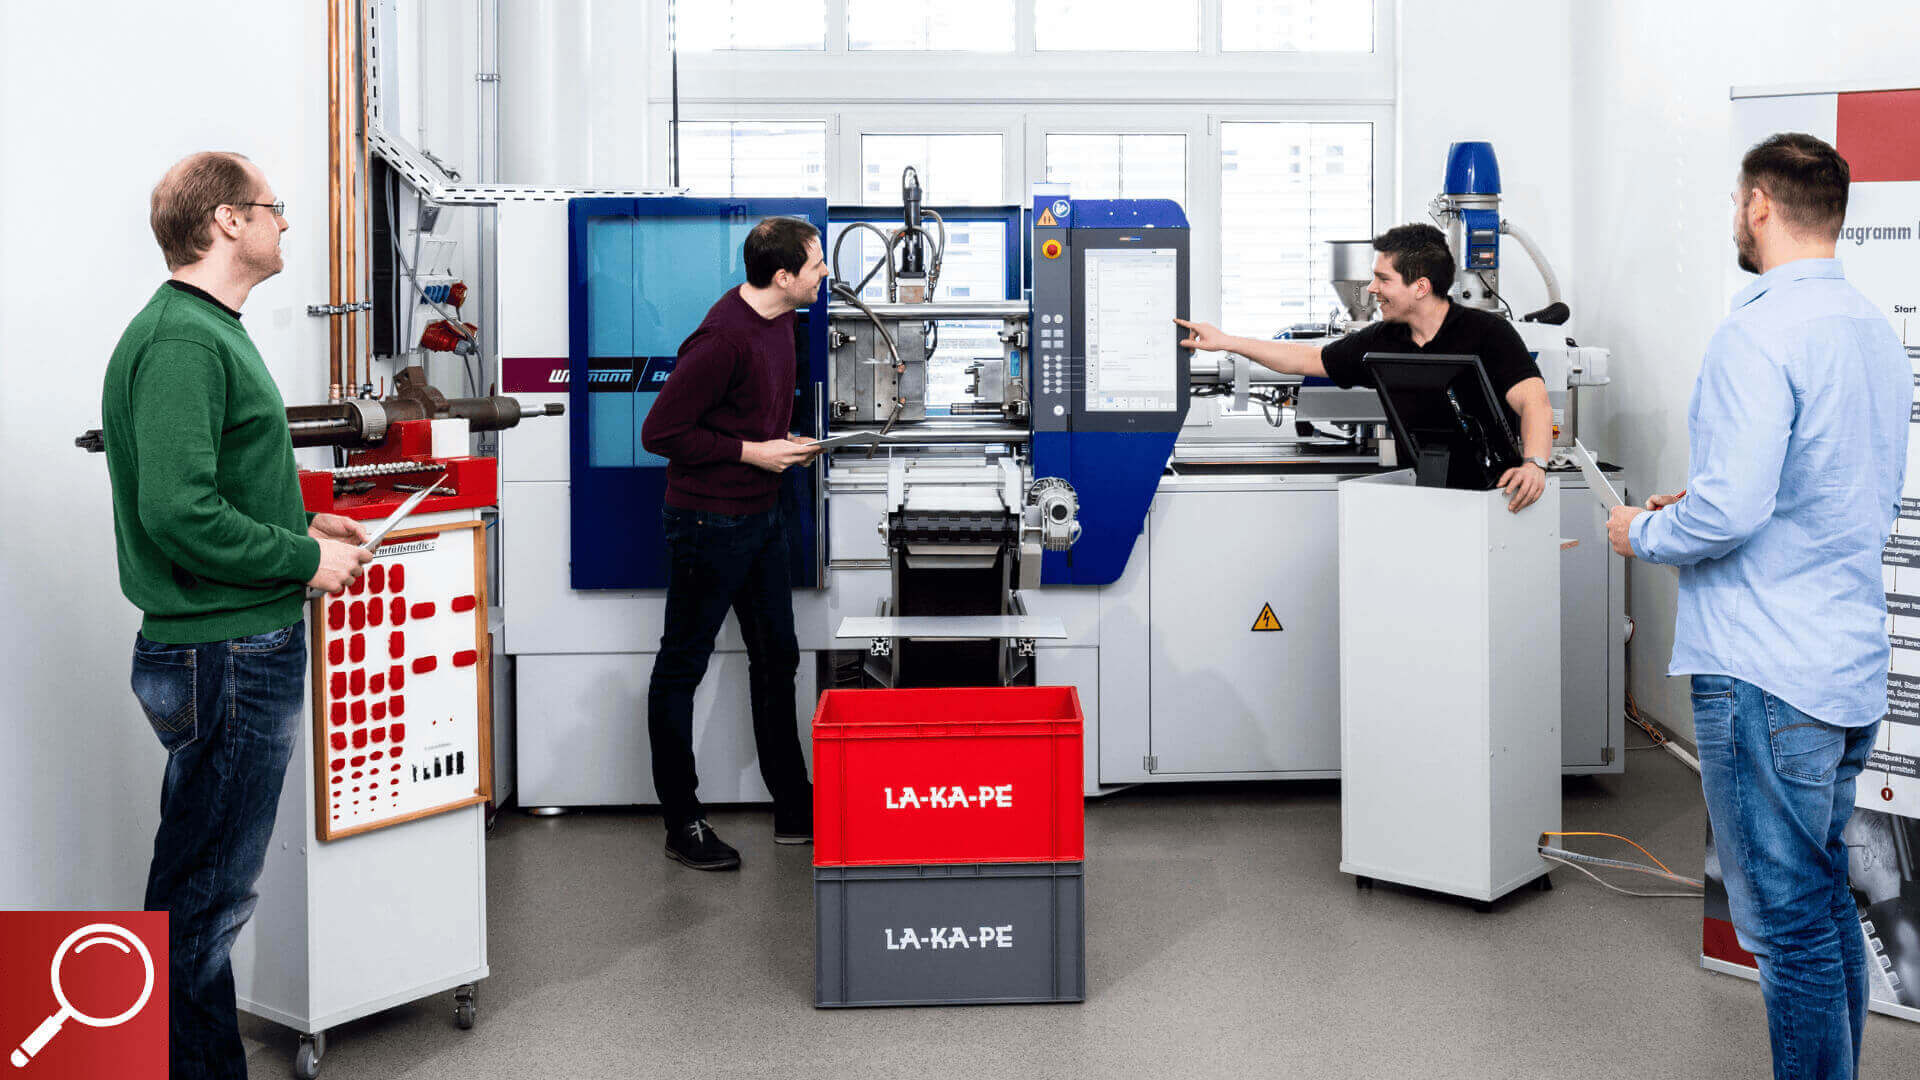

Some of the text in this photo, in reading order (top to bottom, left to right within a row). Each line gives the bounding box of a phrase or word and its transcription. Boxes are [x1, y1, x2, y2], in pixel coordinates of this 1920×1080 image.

[1894, 304, 1917, 314] Start
[884, 784, 1013, 809] LA-KA-PE
[884, 924, 1013, 950] LA-KA-PE
